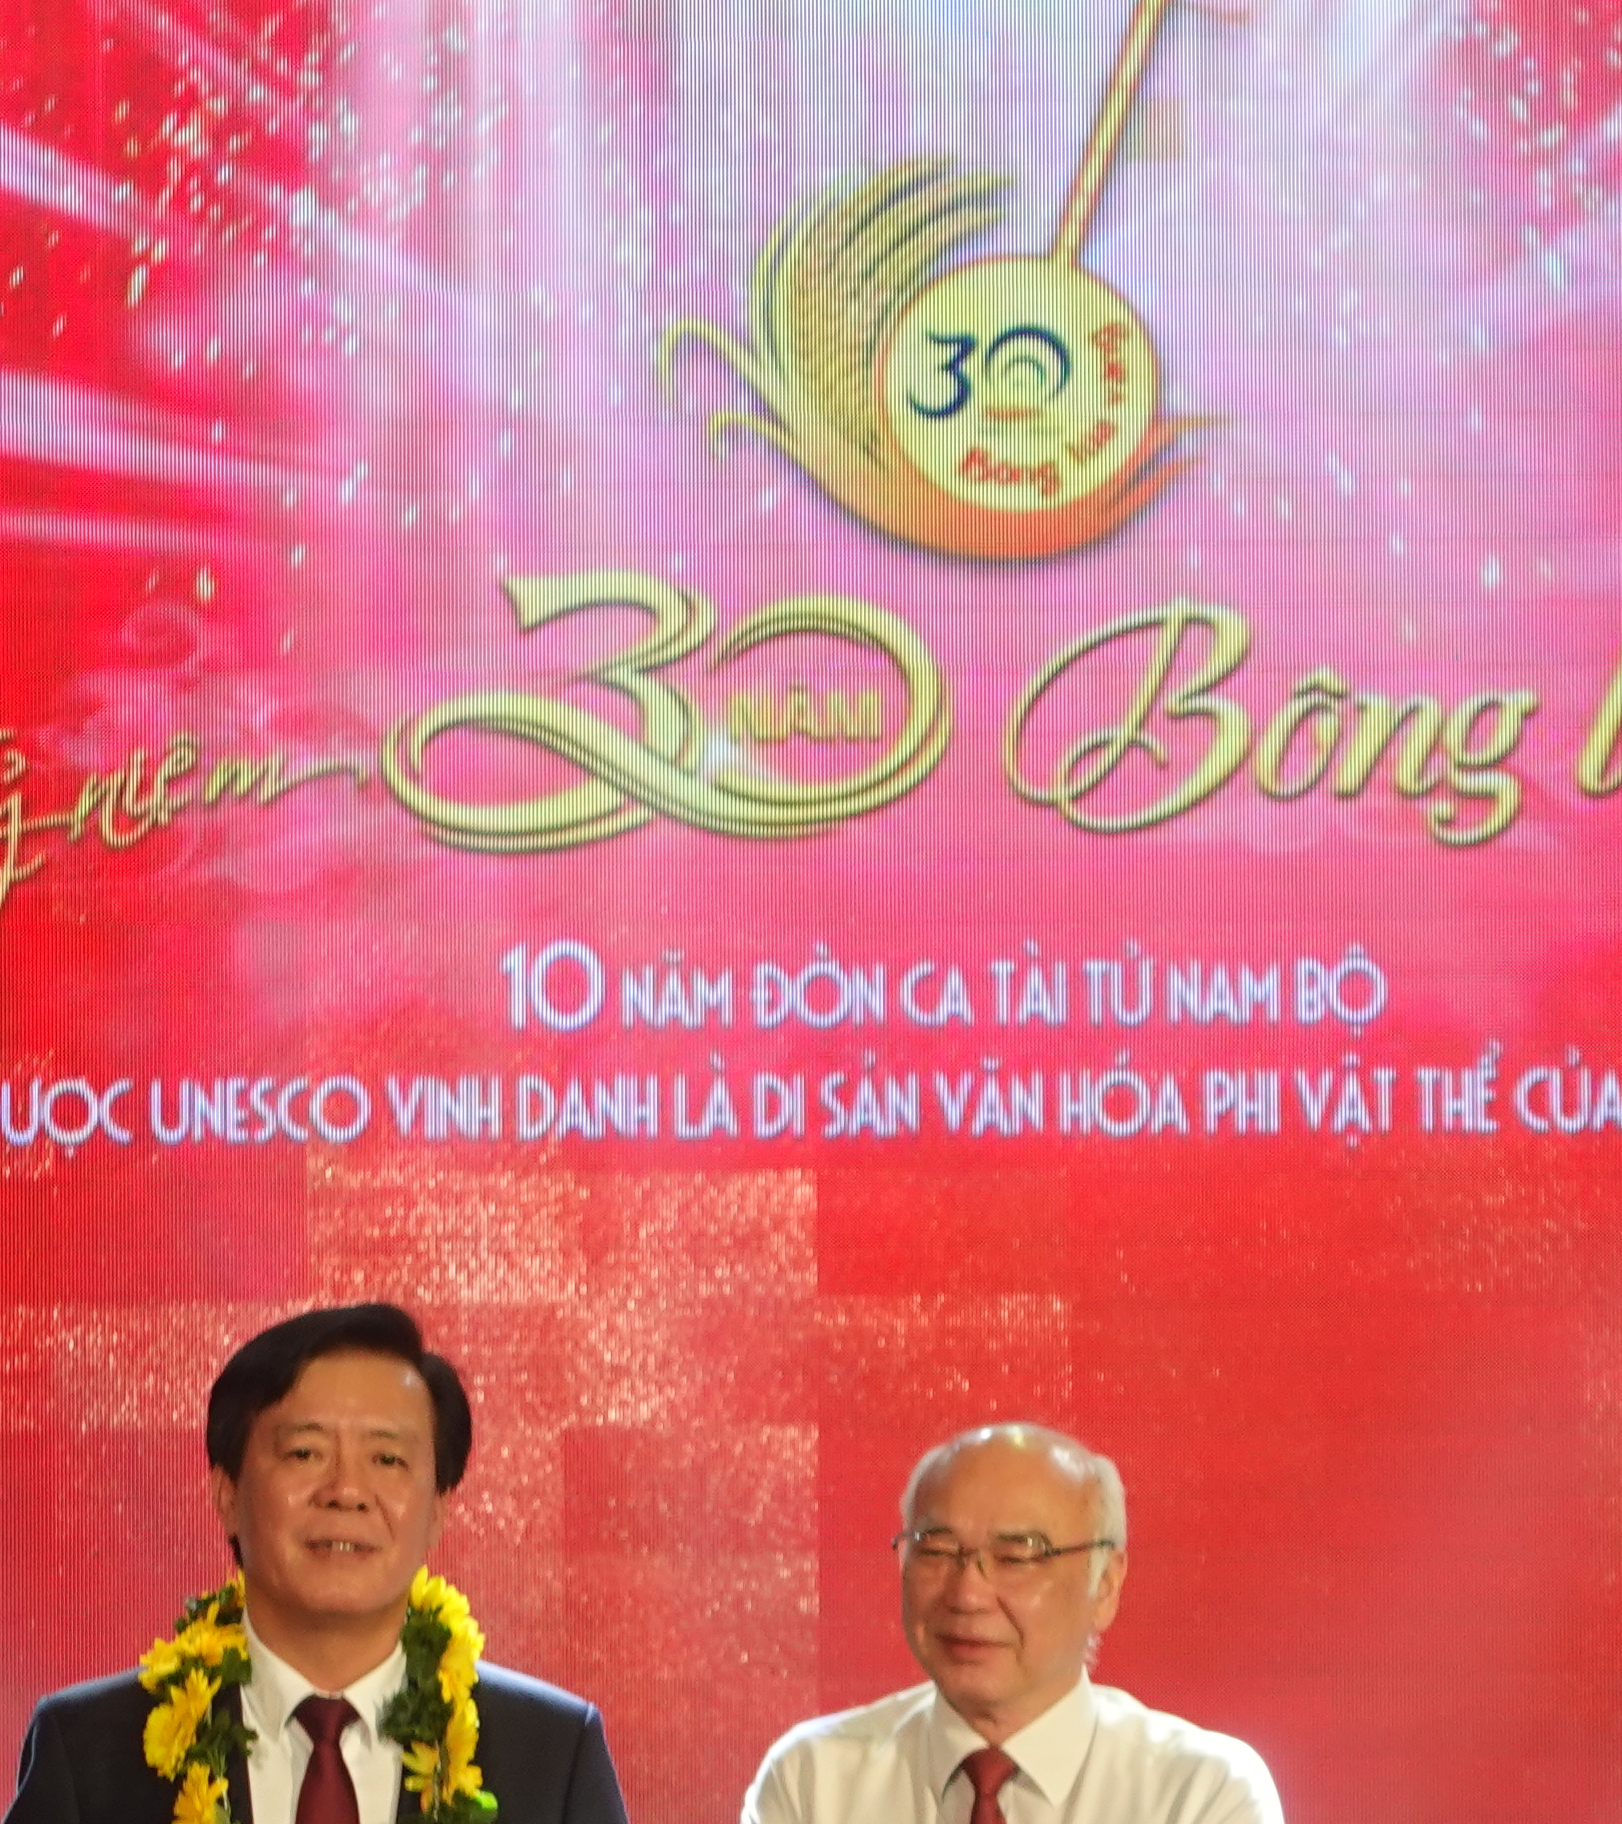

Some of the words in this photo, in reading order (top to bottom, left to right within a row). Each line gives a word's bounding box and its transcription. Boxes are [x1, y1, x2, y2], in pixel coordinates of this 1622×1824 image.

[379, 567, 951, 855] 30
[1001, 593, 1542, 849] Bông
[501, 938, 605, 1032] 10
[620, 949, 734, 1030] NĂM
[899, 960, 975, 1028] CA
[989, 937, 1068, 1027] TÀI
[1165, 955, 1280, 1026] NAM
[1293, 942, 1389, 1040] BỘ
[150, 1073, 372, 1145] UNESCO
[386, 1072, 502, 1143] VINH
[515, 1071, 660, 1142] DANH
[672, 1049, 739, 1140] LÀ
[752, 1070, 806, 1140] DI
[819, 1047, 921, 1139] SẢN
[933, 1055, 1046, 1138] VĂN
[1058, 1048, 1191, 1138] HÓA
[1204, 1066, 1281, 1137] PHI
[1293, 1051, 1398, 1150] VẬT
